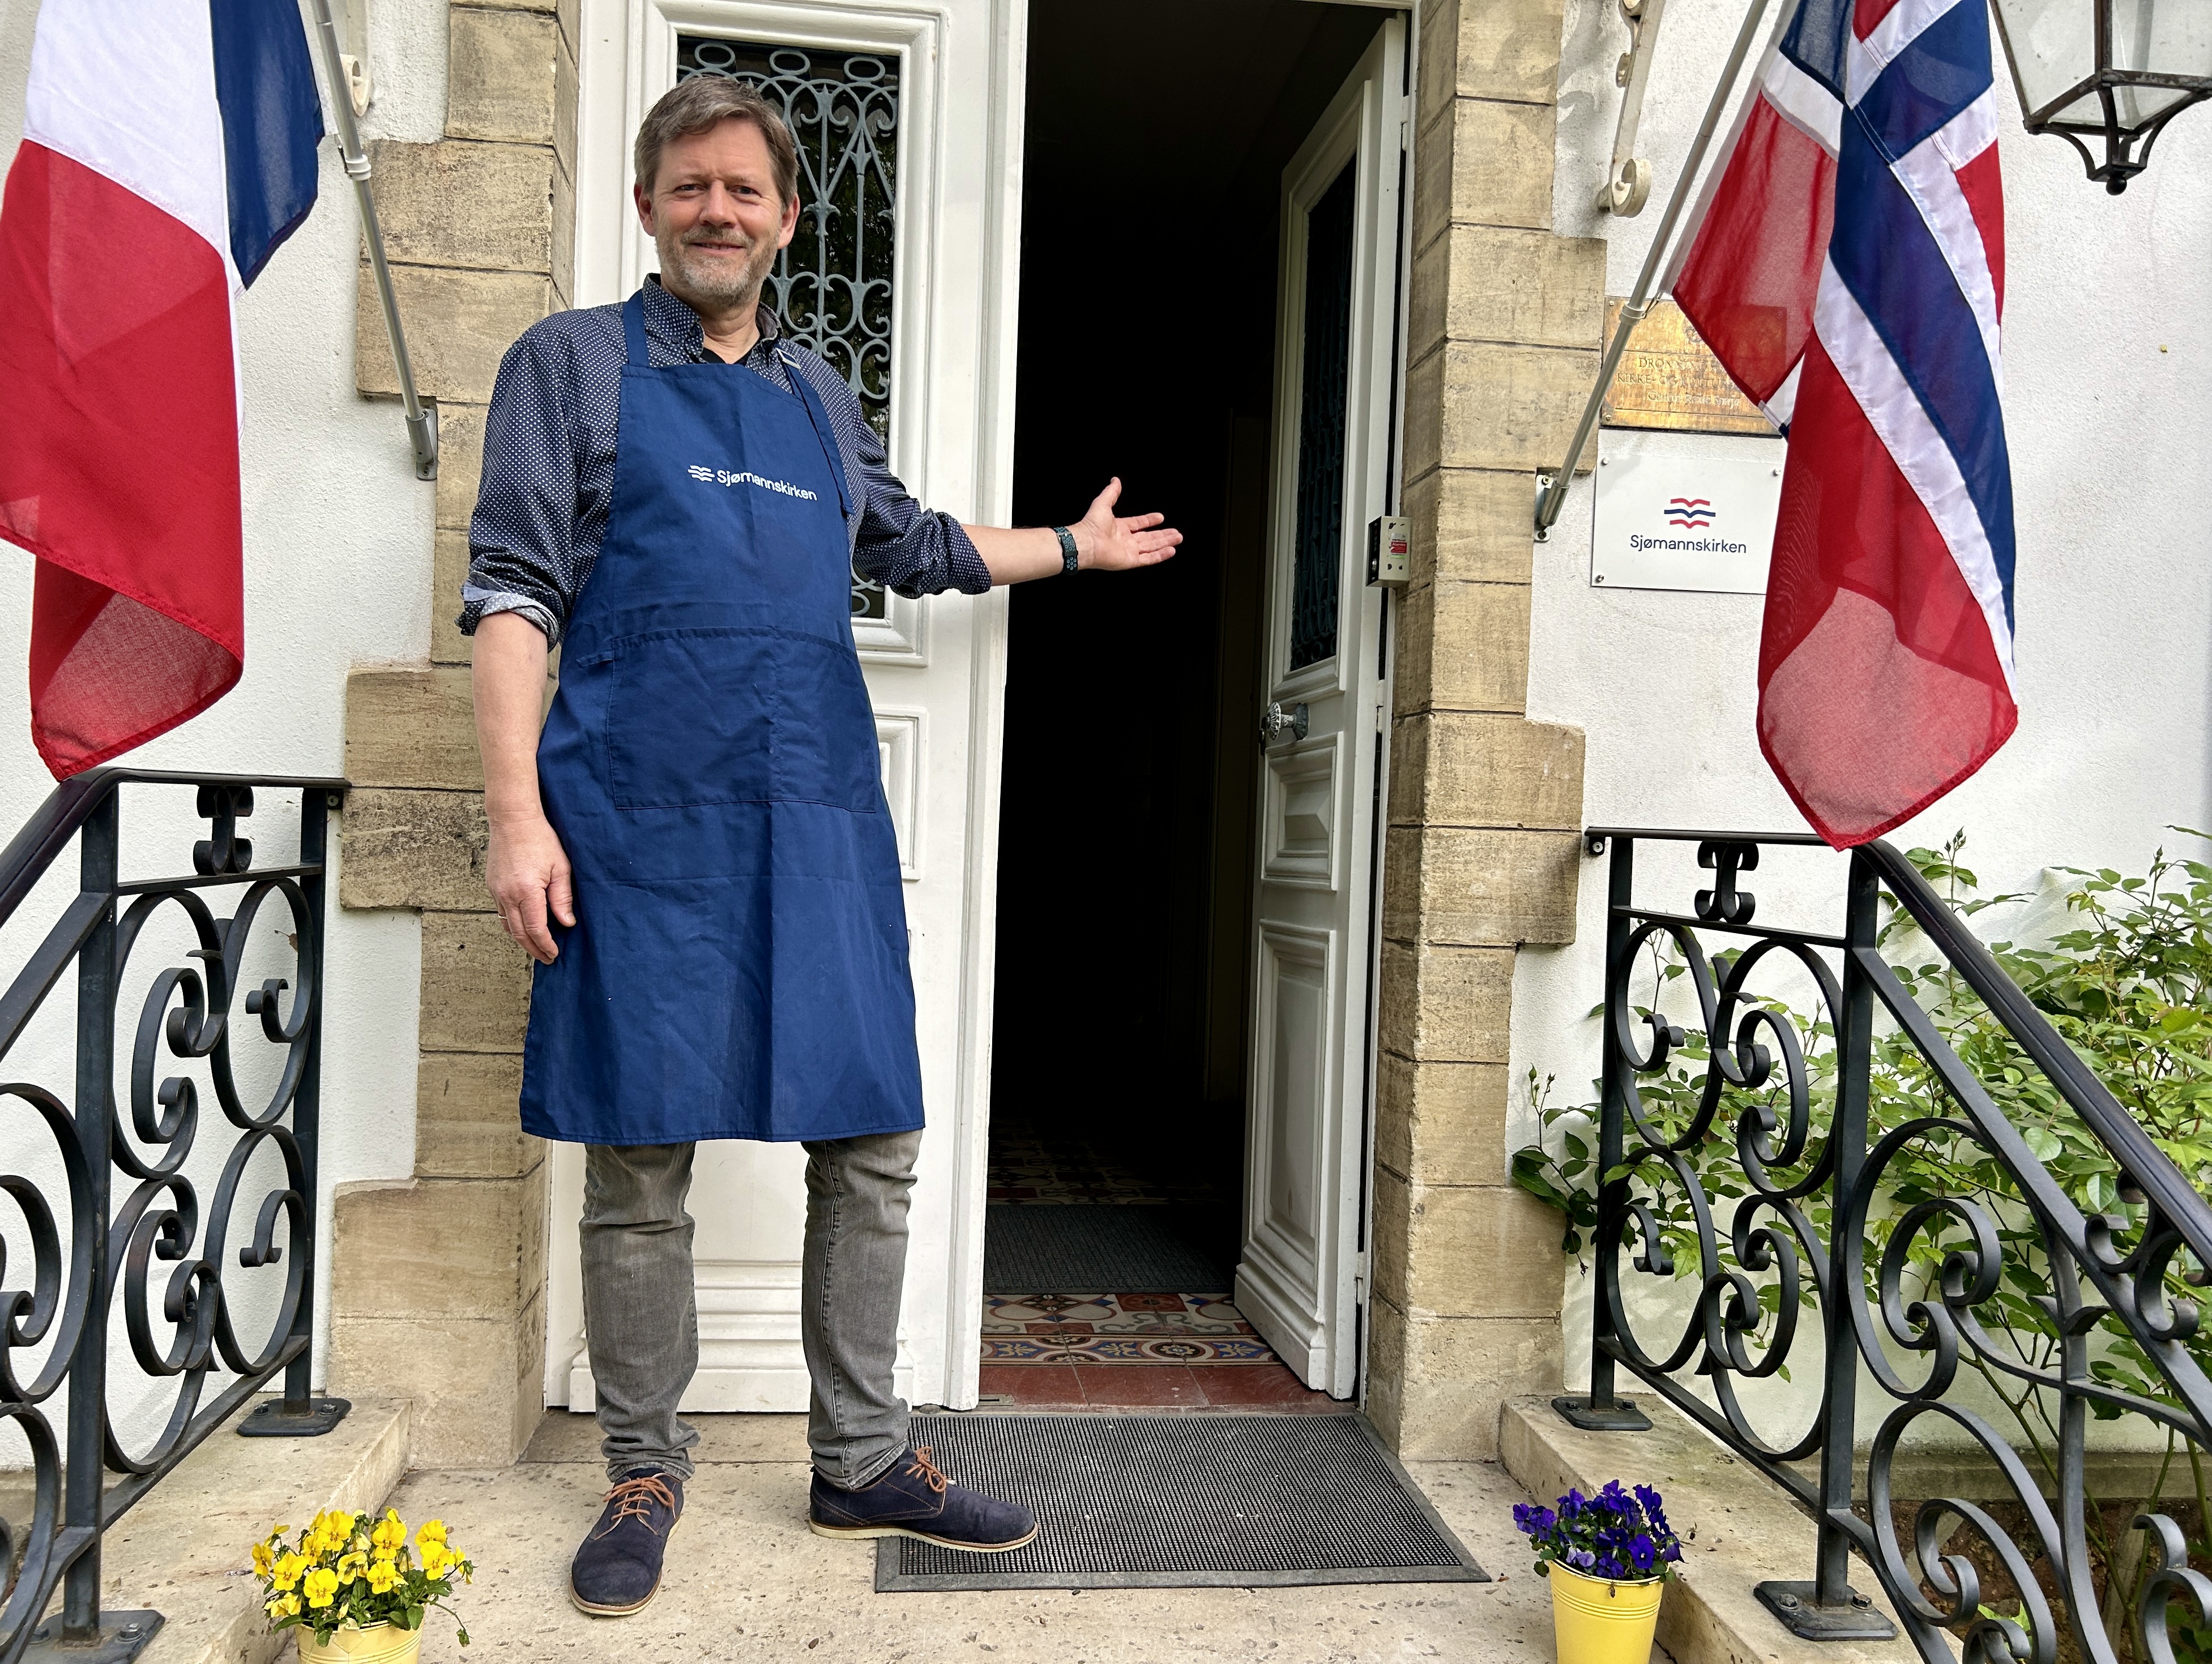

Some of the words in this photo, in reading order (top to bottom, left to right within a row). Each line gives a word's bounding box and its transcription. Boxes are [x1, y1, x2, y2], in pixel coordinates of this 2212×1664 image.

[1617, 373, 1656, 386] KIRKE-
[717, 470, 817, 501] Sjømannskirken
[1630, 534, 1746, 553] Sjømannskirken
